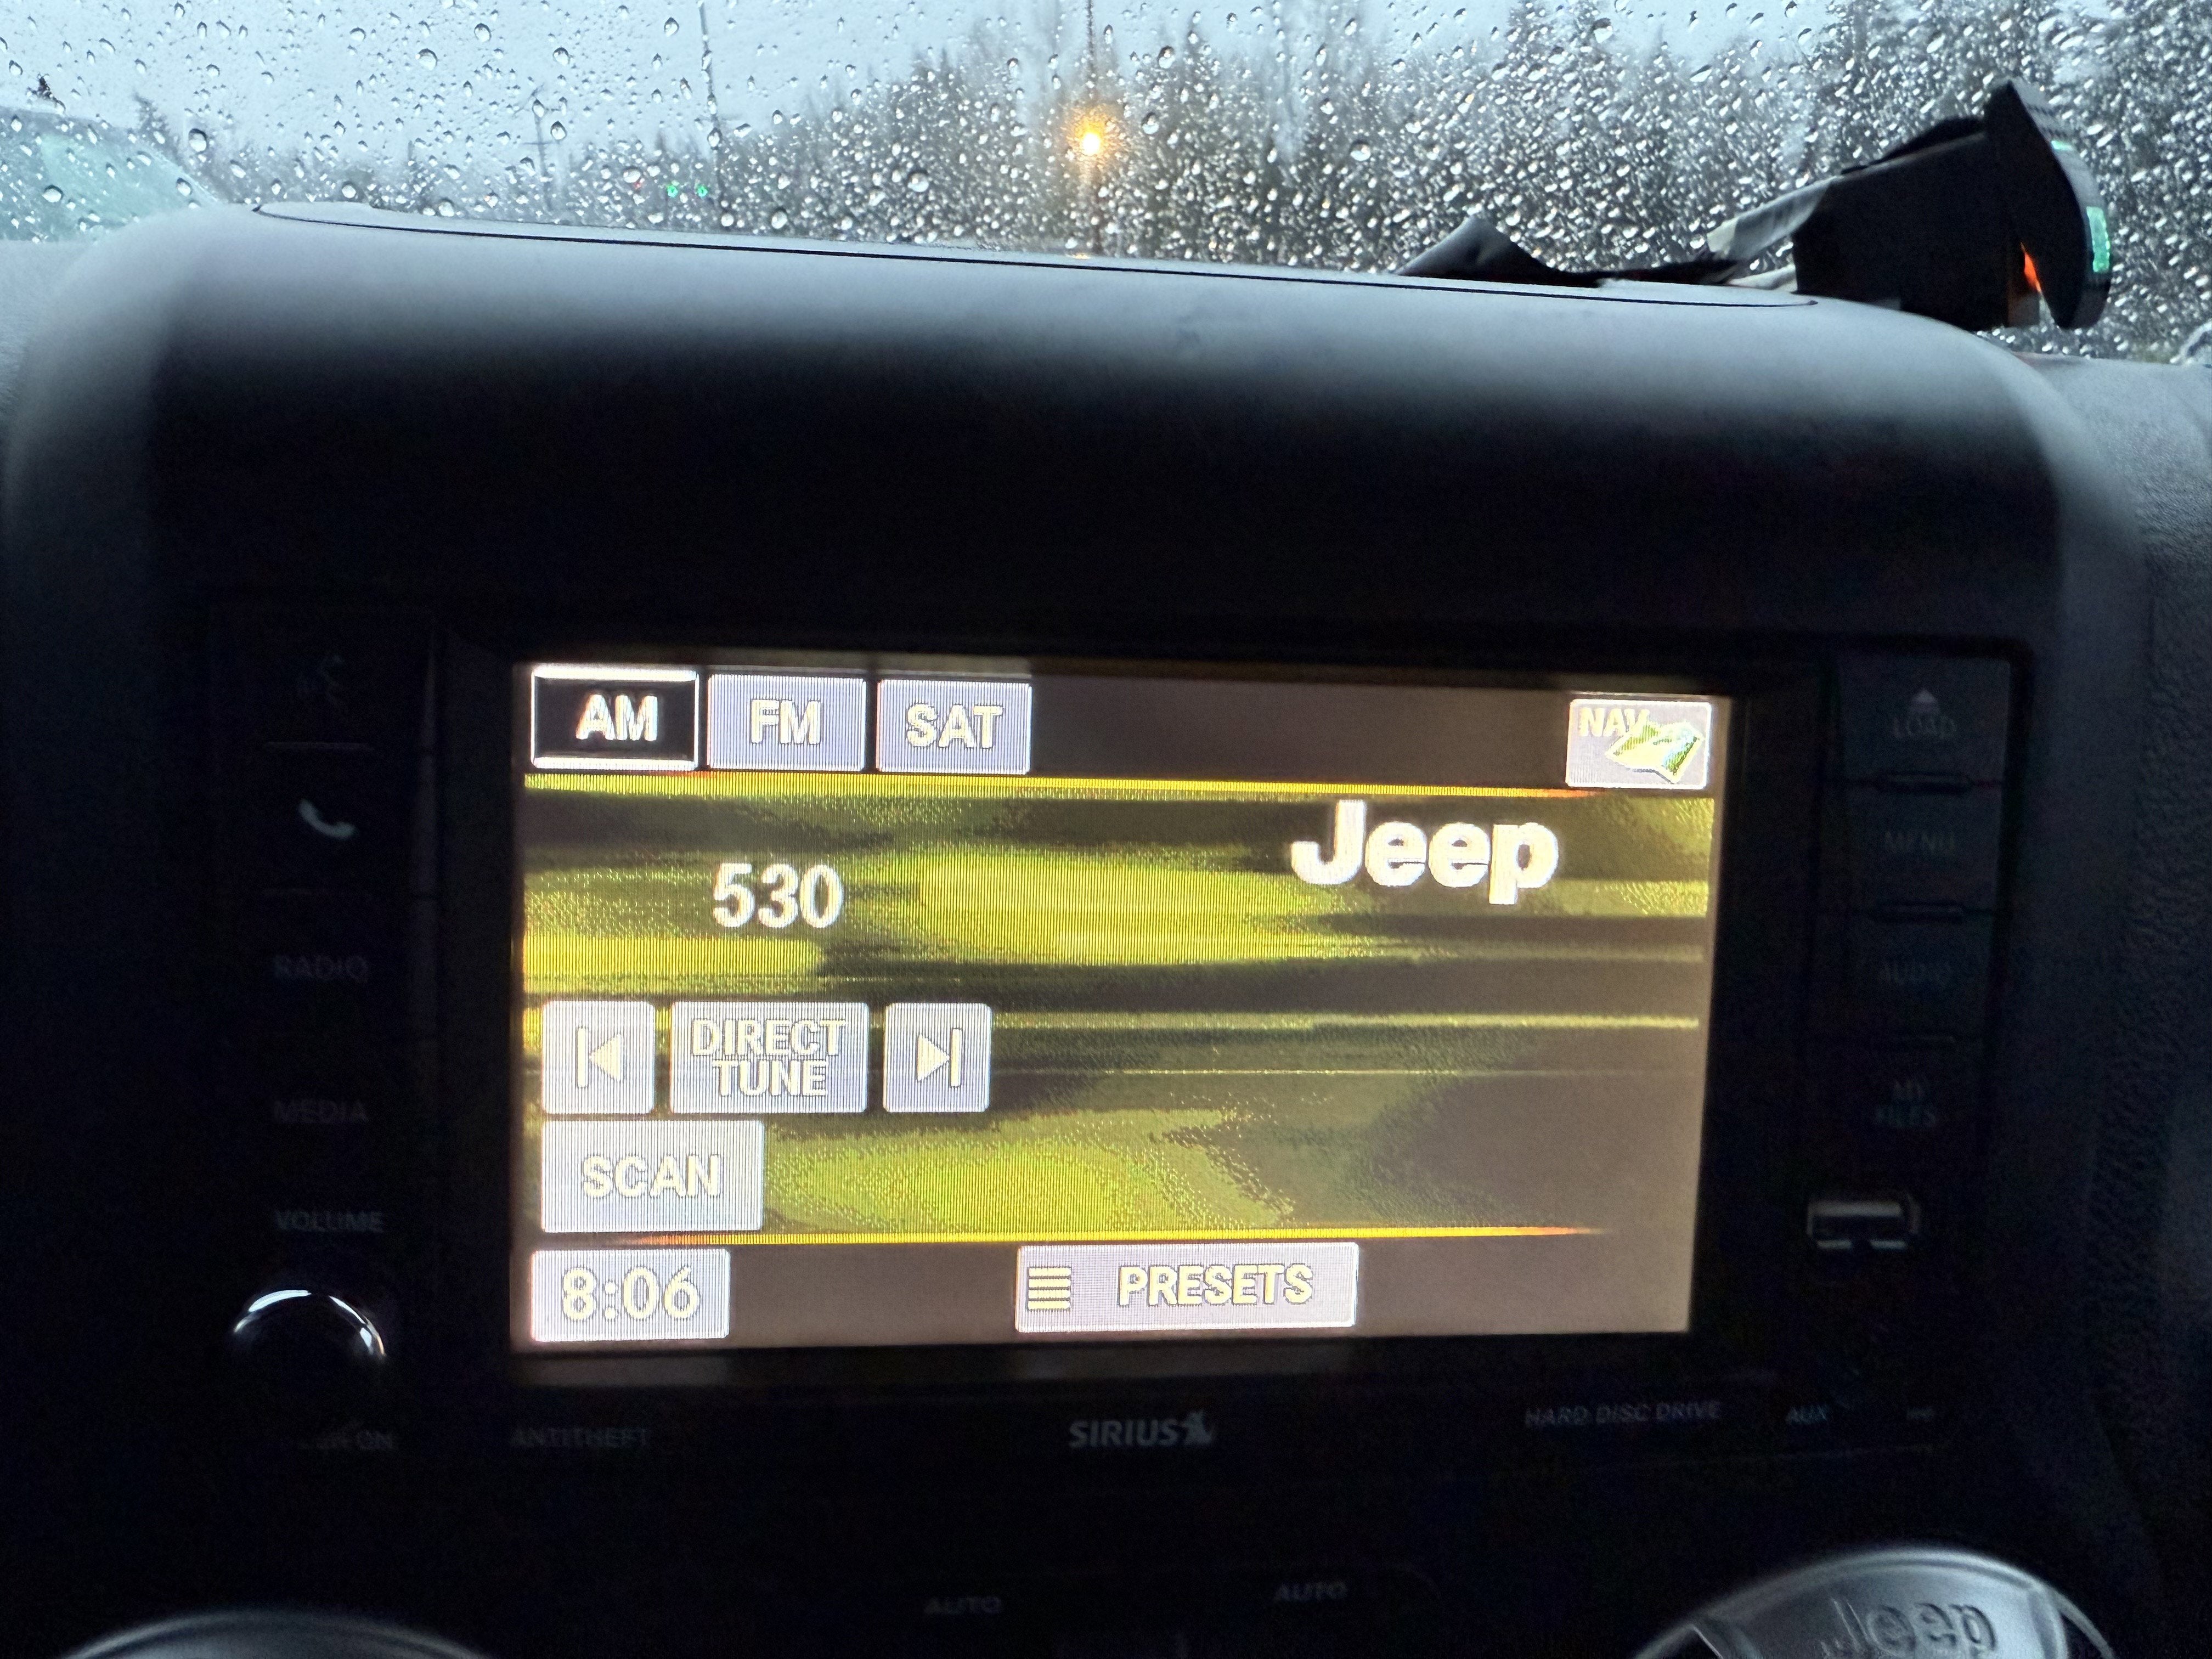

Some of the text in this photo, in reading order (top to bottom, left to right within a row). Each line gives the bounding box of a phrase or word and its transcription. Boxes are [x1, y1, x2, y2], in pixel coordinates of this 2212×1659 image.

[575, 693, 658, 741] AM
[749, 698, 822, 746] FM
[905, 702, 1005, 750] SAT
[1578, 707, 1650, 738] NAV
[1290, 798, 1559, 905] Jeep
[712, 862, 844, 929] 530
[273, 955, 369, 983] RADIO
[690, 1018, 849, 1057] DIRECT
[712, 1058, 830, 1097] TUNE
[273, 1099, 369, 1125] MEDIA
[581, 1153, 723, 1198] SCAN
[273, 1210, 386, 1234] VOLUME
[560, 1266, 702, 1322] 8:06
[1118, 1263, 1314, 1308] PRESETS
[1068, 1418, 1180, 1448] SIRIUS
[1524, 1400, 1722, 1428] HARD DISC DRIVE
[509, 1426, 649, 1449] ANTITHEFT
[923, 1595, 1003, 1615] AUTO
[1272, 1580, 1349, 1603] AUTO
